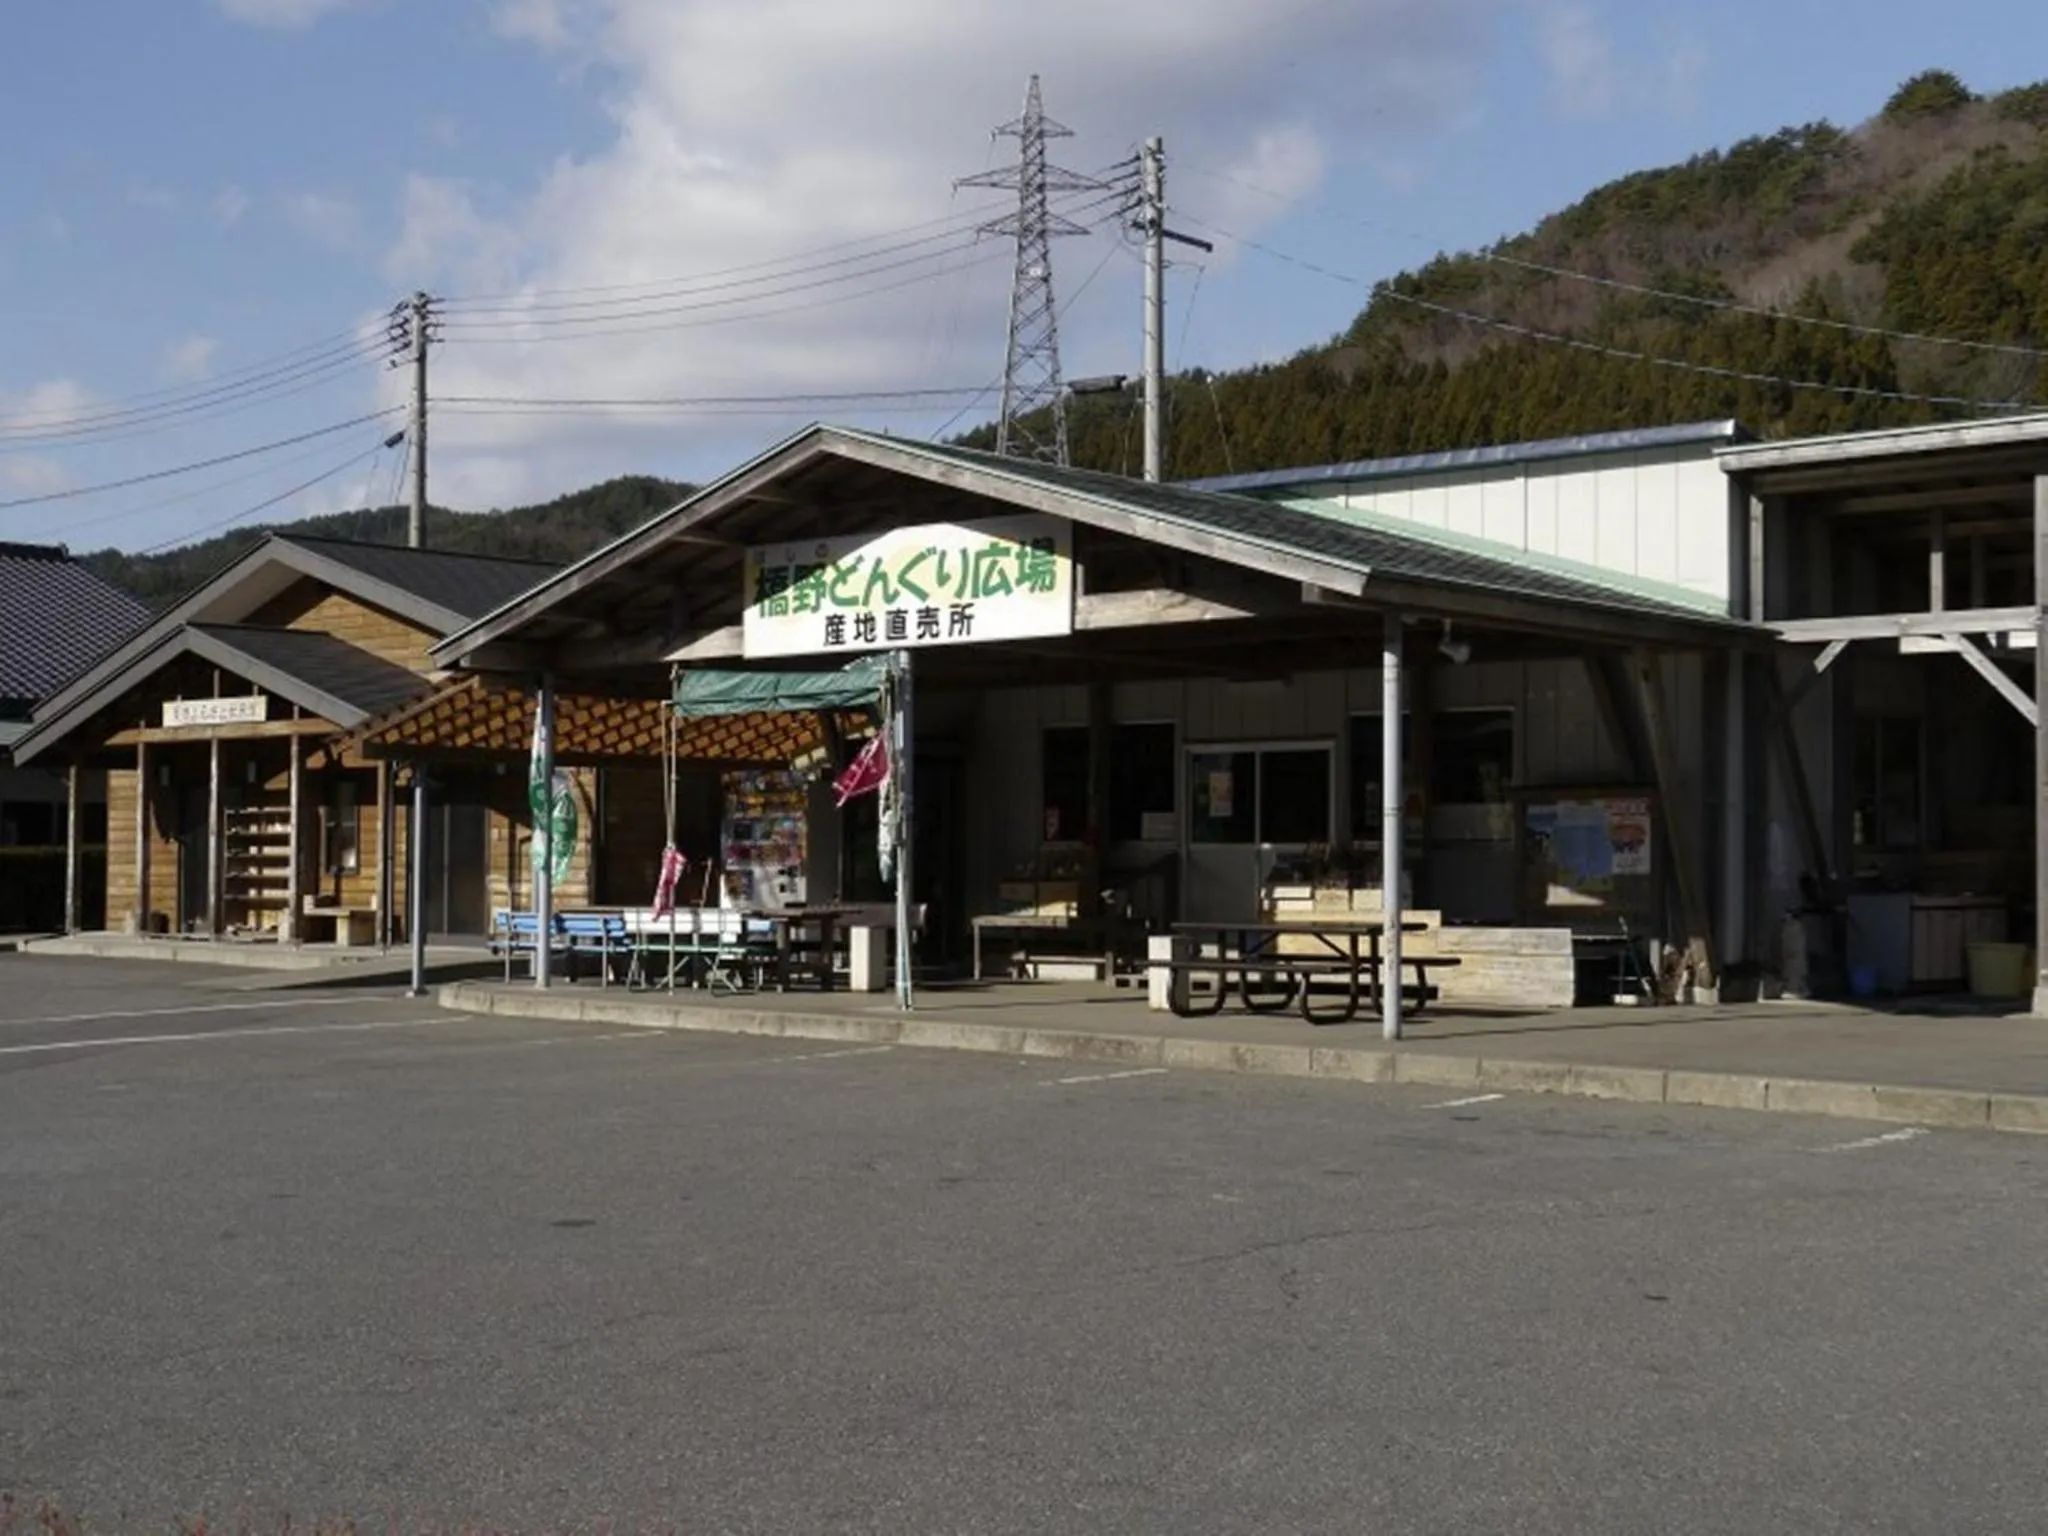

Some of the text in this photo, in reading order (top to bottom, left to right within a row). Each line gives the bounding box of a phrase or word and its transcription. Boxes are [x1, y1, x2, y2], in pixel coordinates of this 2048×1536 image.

[755, 537, 1058, 619] 橋野どんぐり広場
[823, 602, 976, 647] 産地直売所
